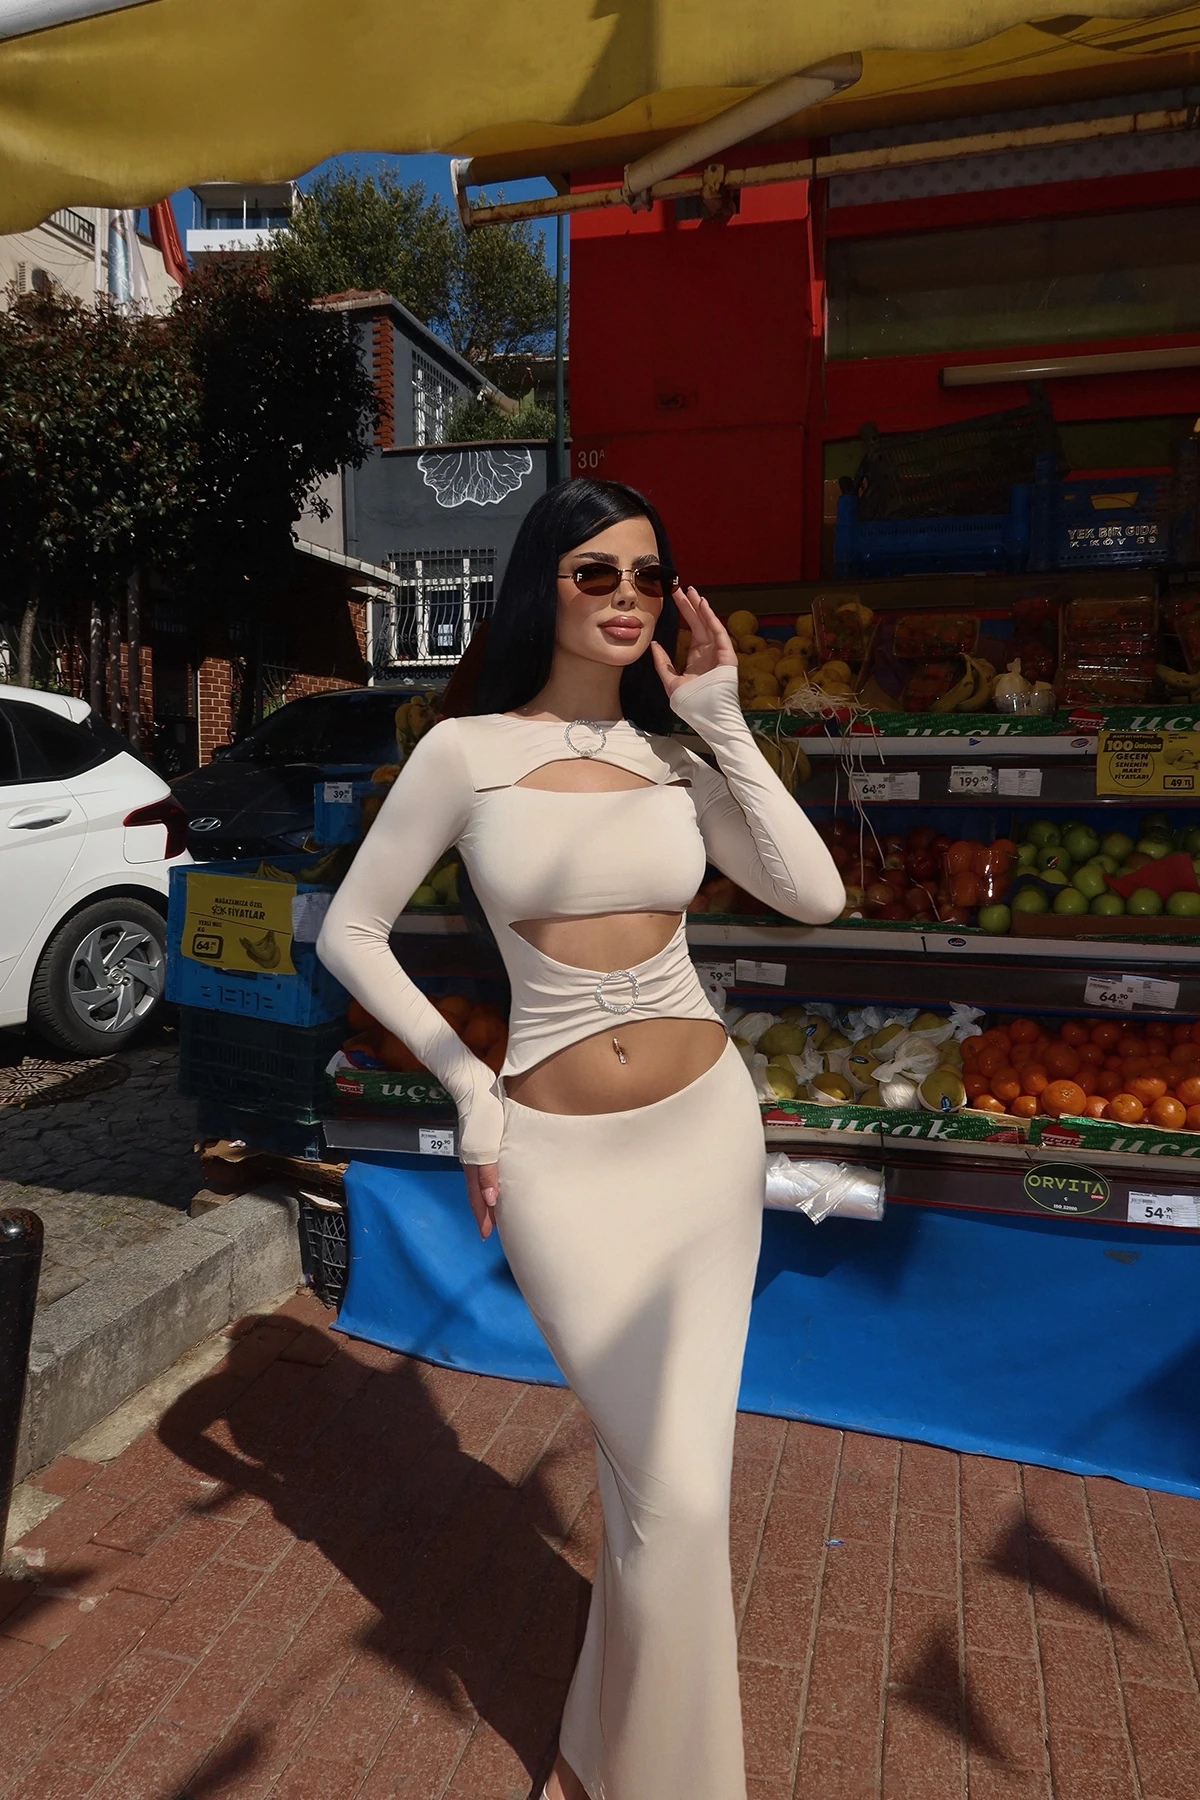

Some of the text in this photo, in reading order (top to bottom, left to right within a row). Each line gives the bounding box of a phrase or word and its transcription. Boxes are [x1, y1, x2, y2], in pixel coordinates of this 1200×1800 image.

[1067, 527, 1096, 540] YEK
[1125, 525, 1159, 537] GIDA
[1106, 739, 1162, 752] 100 ÜRÜNDE
[1115, 752, 1149, 762] GEÇEN
[1114, 772, 1150, 781] FİYATLARI
[1170, 778, 1182, 788] 49
[249, 900, 263, 909] ÖZEL
[227, 905, 266, 920] FİYATLAR
[1027, 1174, 1105, 1197] ORVITA
